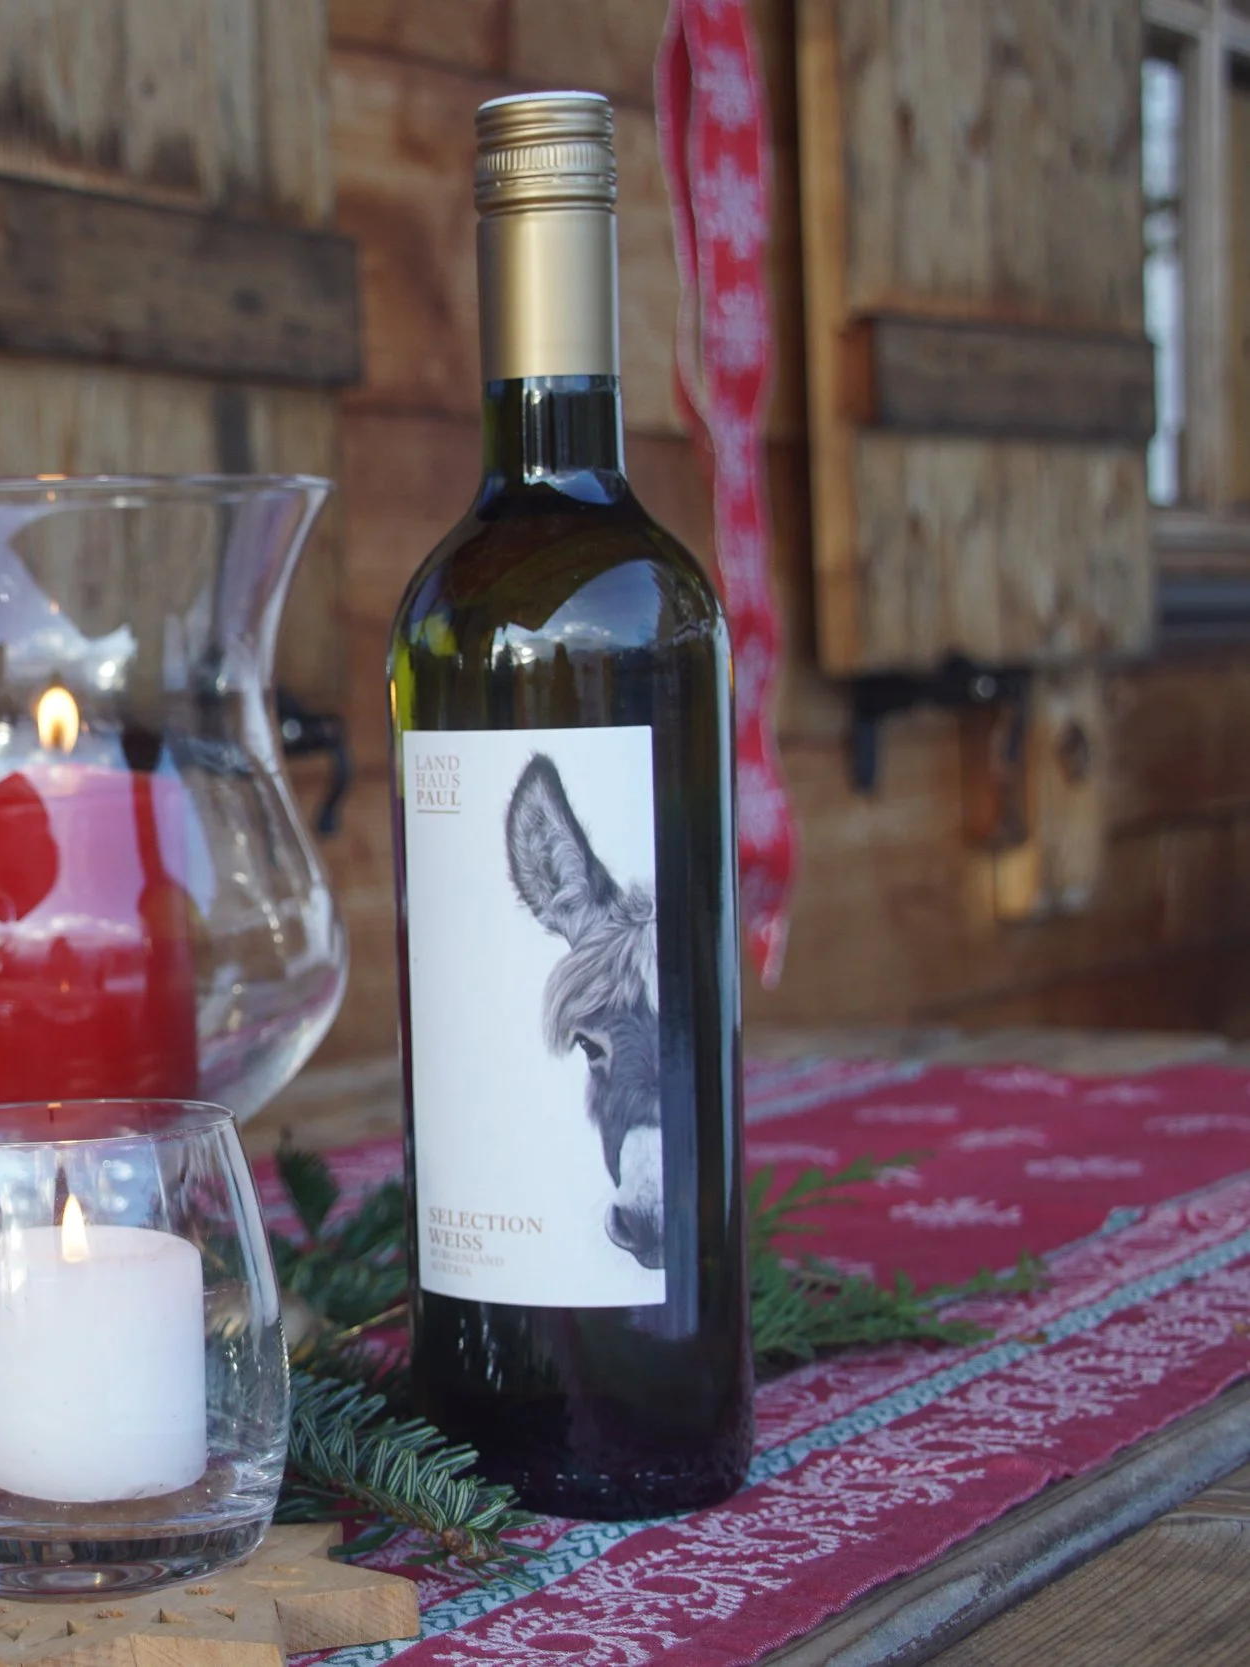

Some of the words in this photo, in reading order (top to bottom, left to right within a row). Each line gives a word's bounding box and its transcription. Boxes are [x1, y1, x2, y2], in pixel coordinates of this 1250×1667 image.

[415, 754, 461, 771] LAND
[415, 773, 461, 789] HAUS
[416, 789, 462, 806] PAUL
[428, 1206, 543, 1234] SELECTION
[429, 1226, 483, 1251] WEISS
